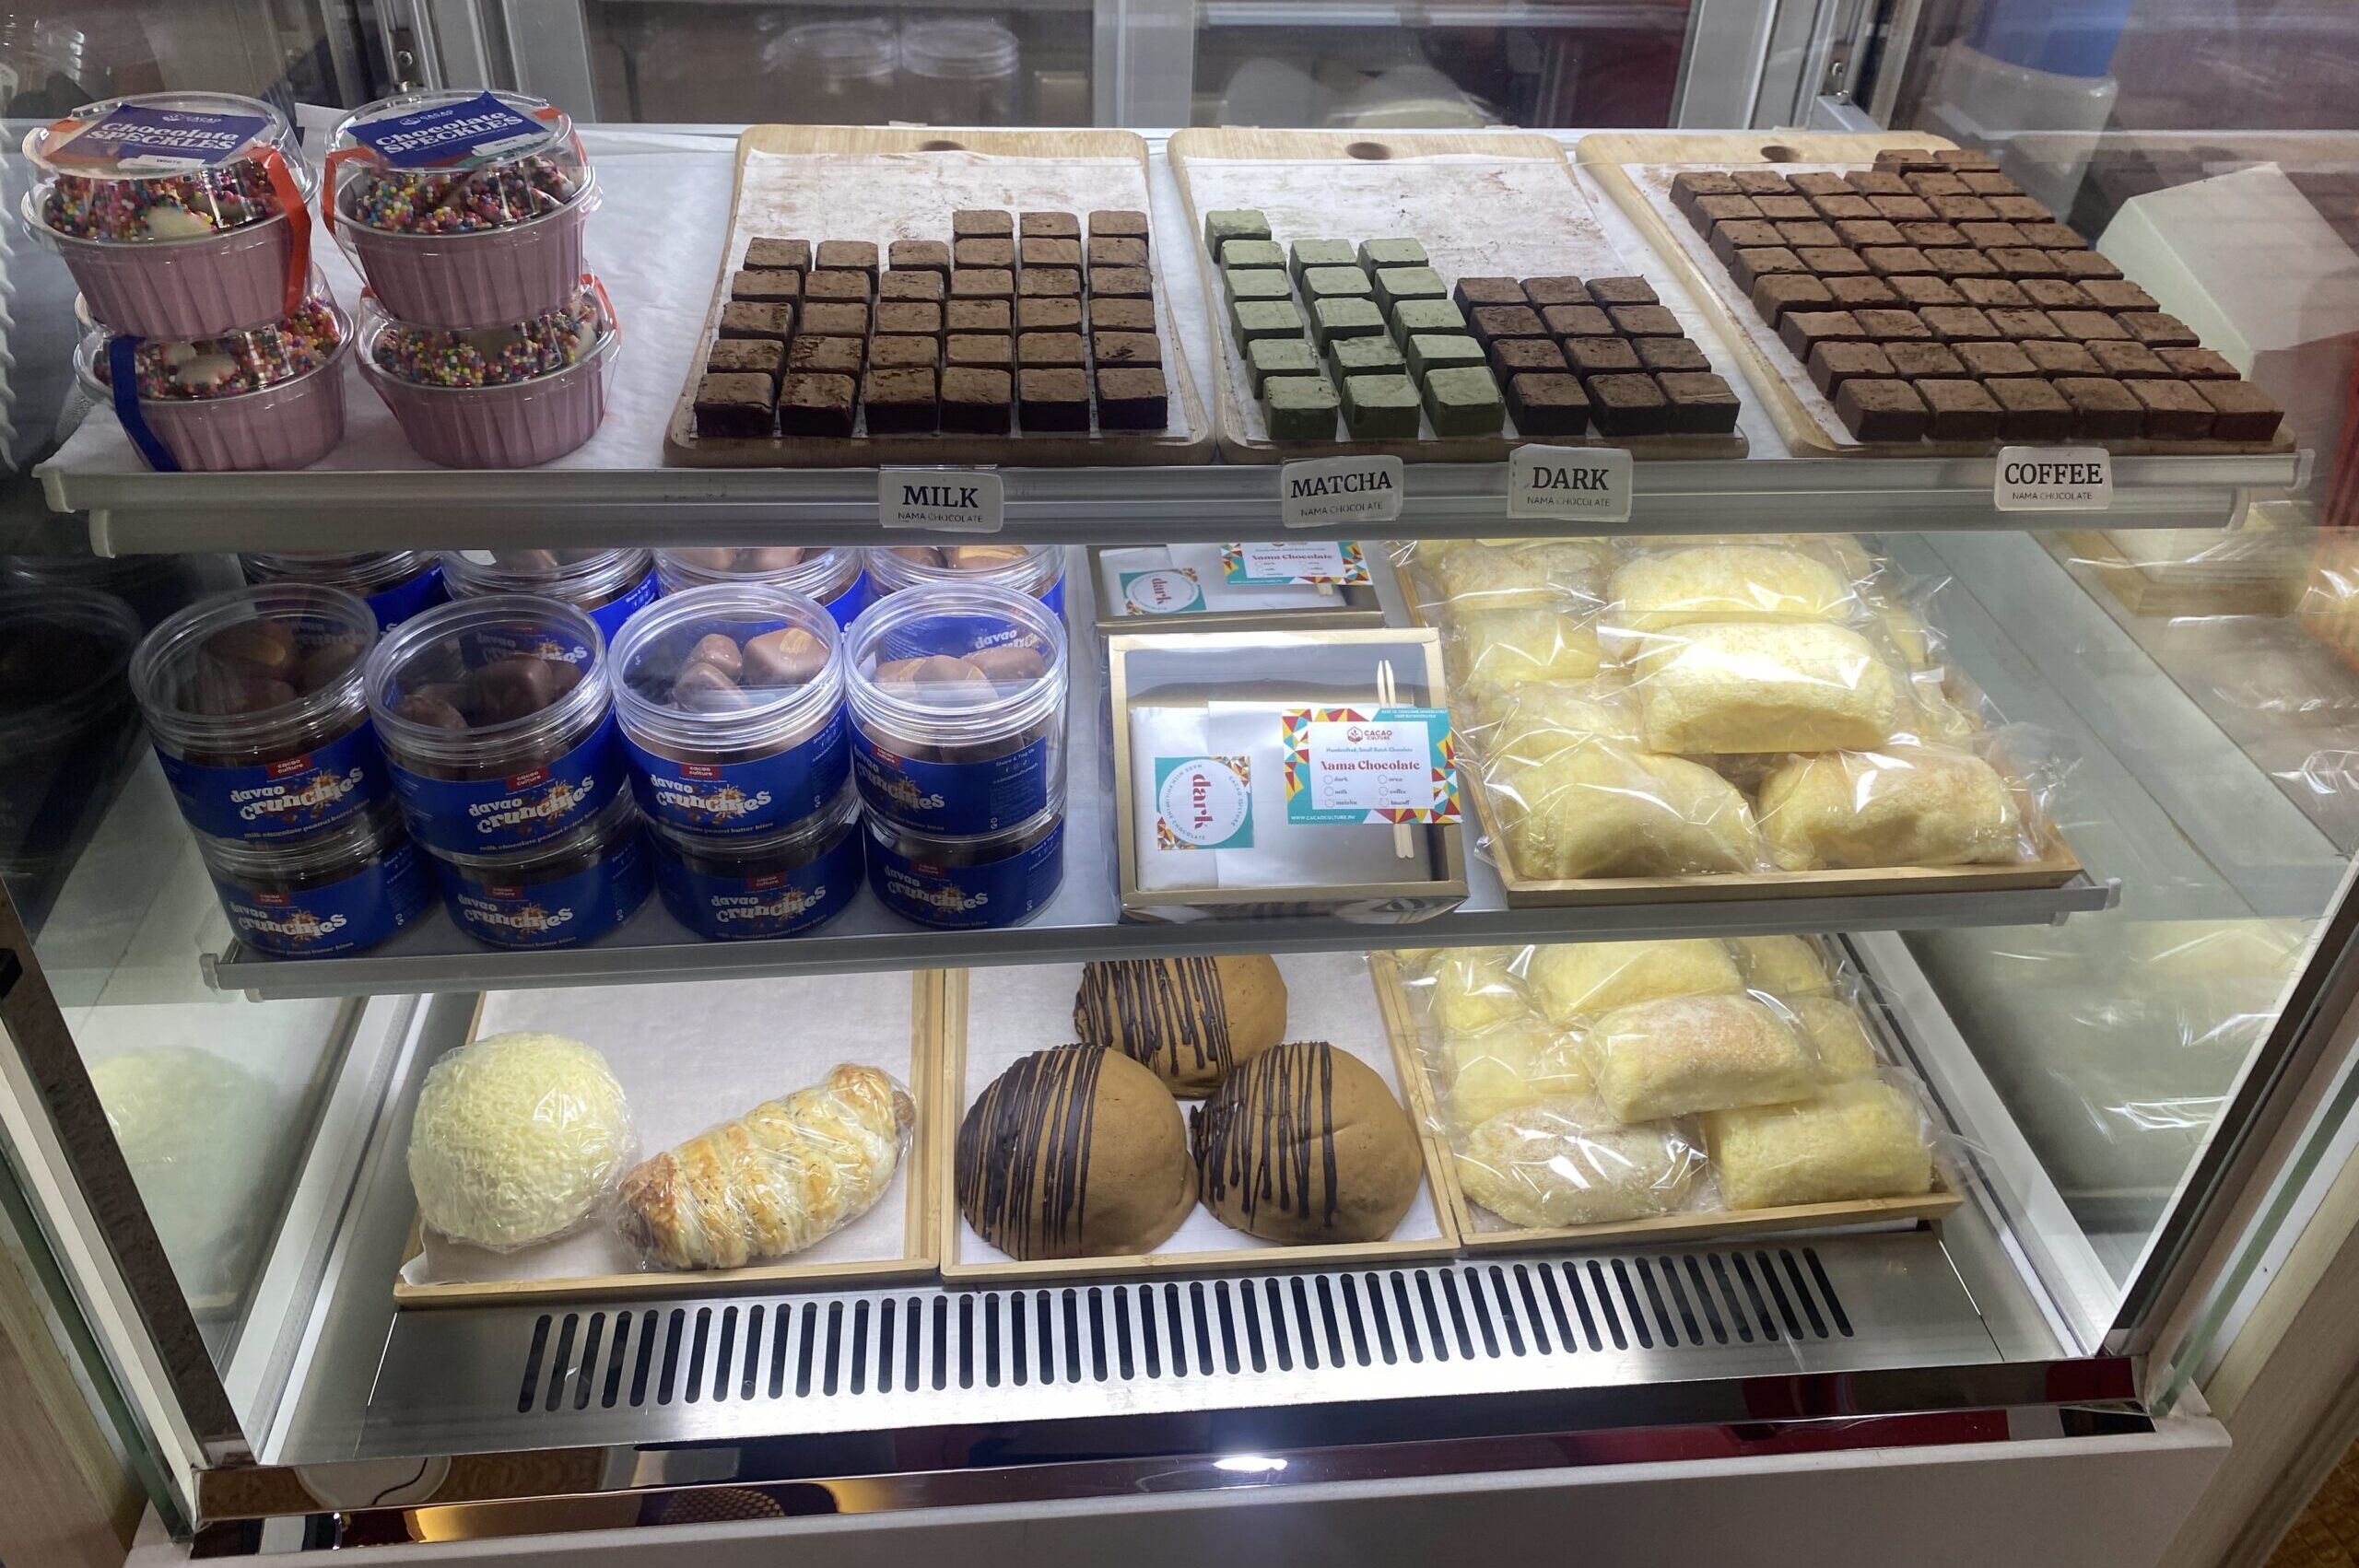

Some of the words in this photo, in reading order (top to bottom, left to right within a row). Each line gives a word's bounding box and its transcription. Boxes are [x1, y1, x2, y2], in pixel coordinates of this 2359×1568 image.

[100, 123, 240, 141] Chocolate
[375, 112, 507, 146] Chocolate
[383, 115, 523, 154] SPECKLES
[87, 130, 236, 150] SPECKLES
[1532, 466, 1609, 490] DARK
[2004, 462, 2103, 485] COFFEE
[1290, 471, 1392, 497] MATCHA
[902, 486, 979, 509] MILK
[1555, 497, 1610, 507] CHOCOLATE
[2013, 492, 2038, 500] NAMA
[2039, 492, 2093, 500] CHOCOLATE
[927, 513, 984, 522] CHOCOLATE
[1301, 506, 1328, 516] NAMA
[1329, 501, 1383, 514] CHOCOLATE
[1152, 578, 1172, 605] dark
[975, 629, 1017, 649] davao
[277, 759, 301, 768] cacao
[277, 763, 303, 774] culture
[1320, 760, 1356, 770] Nama
[1357, 760, 1420, 770] Chocolate
[516, 771, 539, 780] cacao
[516, 775, 542, 786] culture
[651, 774, 693, 793] davao
[230, 786, 285, 802] davao
[240, 766, 364, 820] crunchies
[656, 790, 772, 814] crunchies
[1192, 774, 1213, 829] dark
[468, 798, 522, 816] davao
[477, 776, 594, 834] crunchies
[710, 895, 759, 907] davao
[716, 885, 827, 922] crunchies
[887, 881, 989, 912] crunchies
[239, 913, 346, 937] crunchies
[464, 907, 573, 930] crunchies
